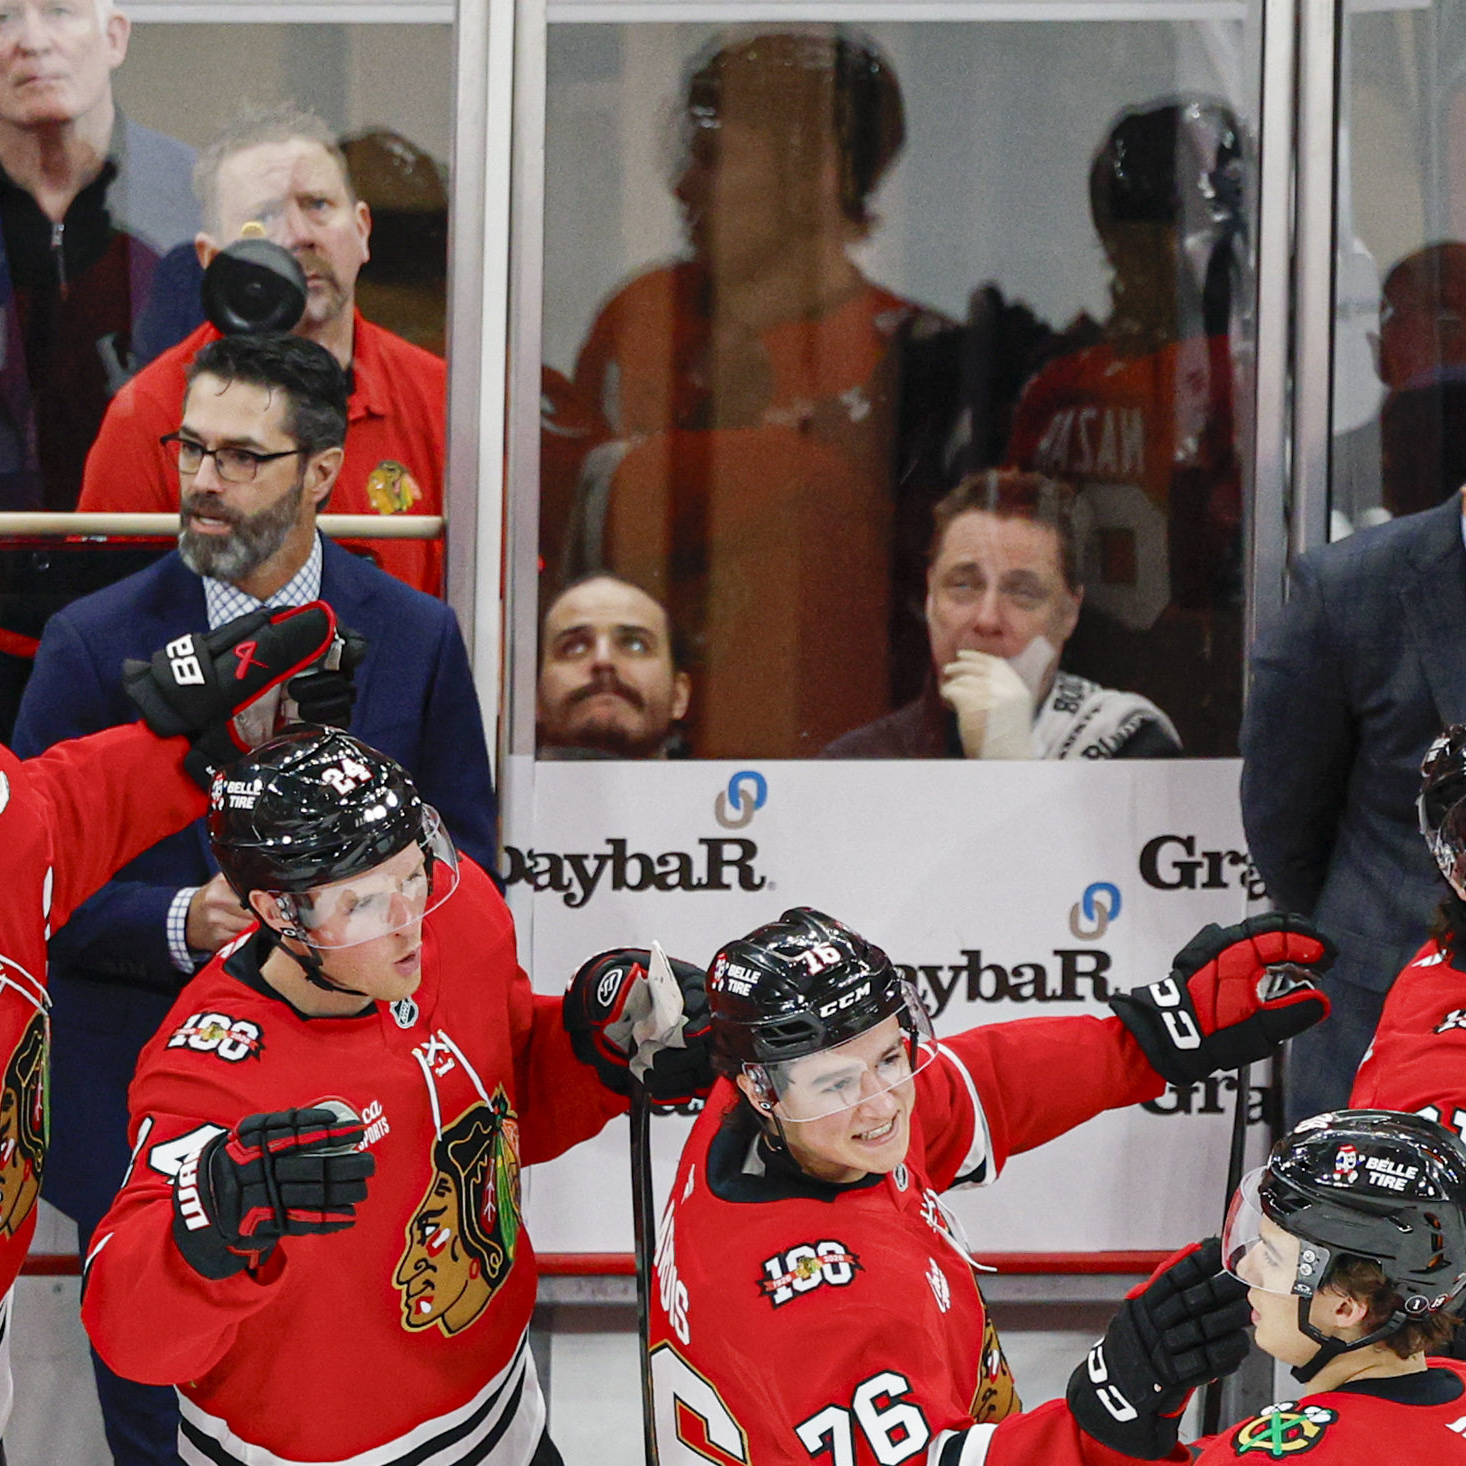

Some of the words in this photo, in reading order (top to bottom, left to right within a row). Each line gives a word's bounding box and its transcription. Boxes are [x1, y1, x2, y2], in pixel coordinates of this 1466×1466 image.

[227, 780, 263, 797] BELLE
[321, 757, 375, 797] 24
[228, 795, 257, 811] TIRE
[794, 941, 843, 977] 76
[727, 965, 762, 985] BELLE
[726, 980, 753, 998] TIRE
[818, 981, 872, 1019] CCM
[1365, 1156, 1419, 1181] BELLE
[1368, 1171, 1408, 1192] TIRE
[764, 1240, 855, 1306] 100
